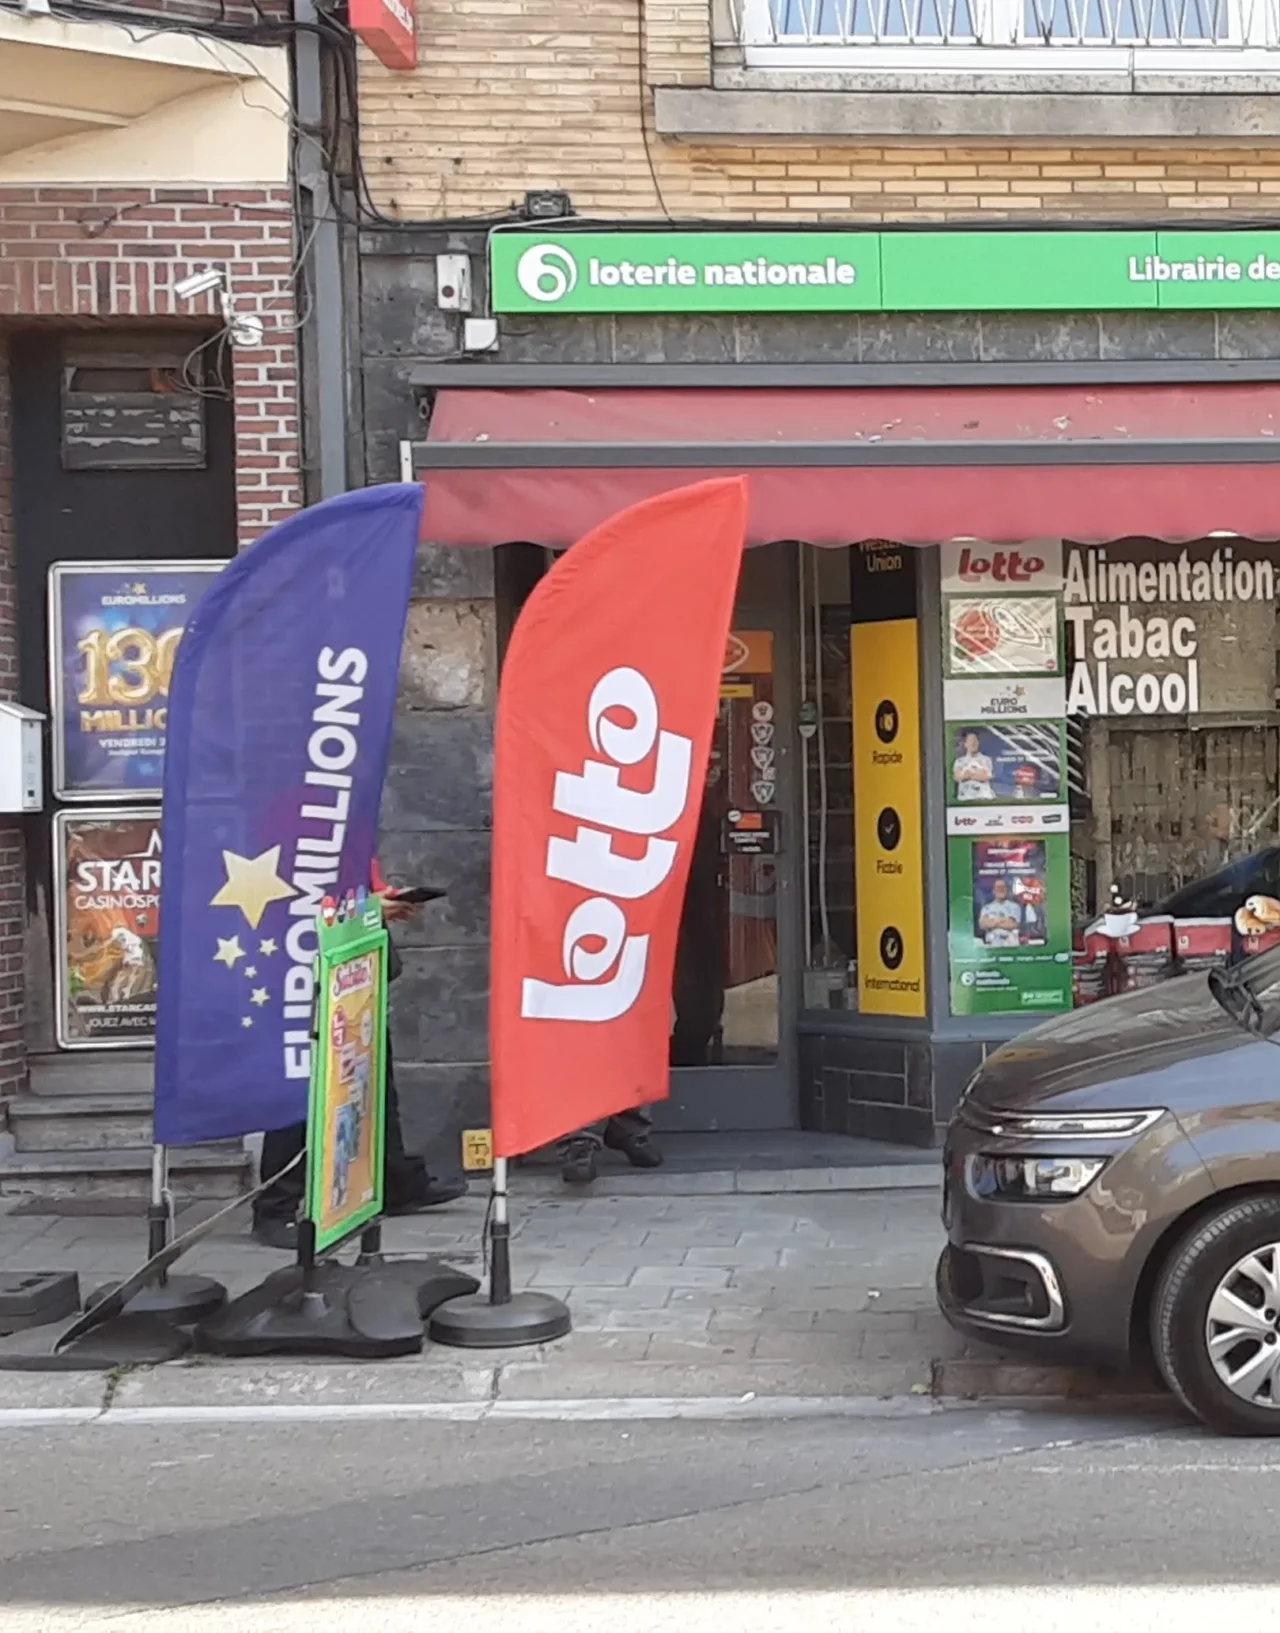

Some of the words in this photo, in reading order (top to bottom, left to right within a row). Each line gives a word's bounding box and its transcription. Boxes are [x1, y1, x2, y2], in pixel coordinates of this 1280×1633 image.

[589, 258, 696, 286] loterie
[704, 257, 856, 286] nationale
[1128, 255, 1241, 281] Librairie
[866, 554, 902, 572] Union
[1062, 547, 1274, 603] Alimentation
[101, 594, 187, 606] EUROMILLIONS
[1065, 605, 1198, 660] Tabac
[1067, 659, 1199, 715] Alcool
[872, 751, 903, 766] Rapide
[876, 859, 903, 875] Fiable
[864, 973, 921, 993] International
